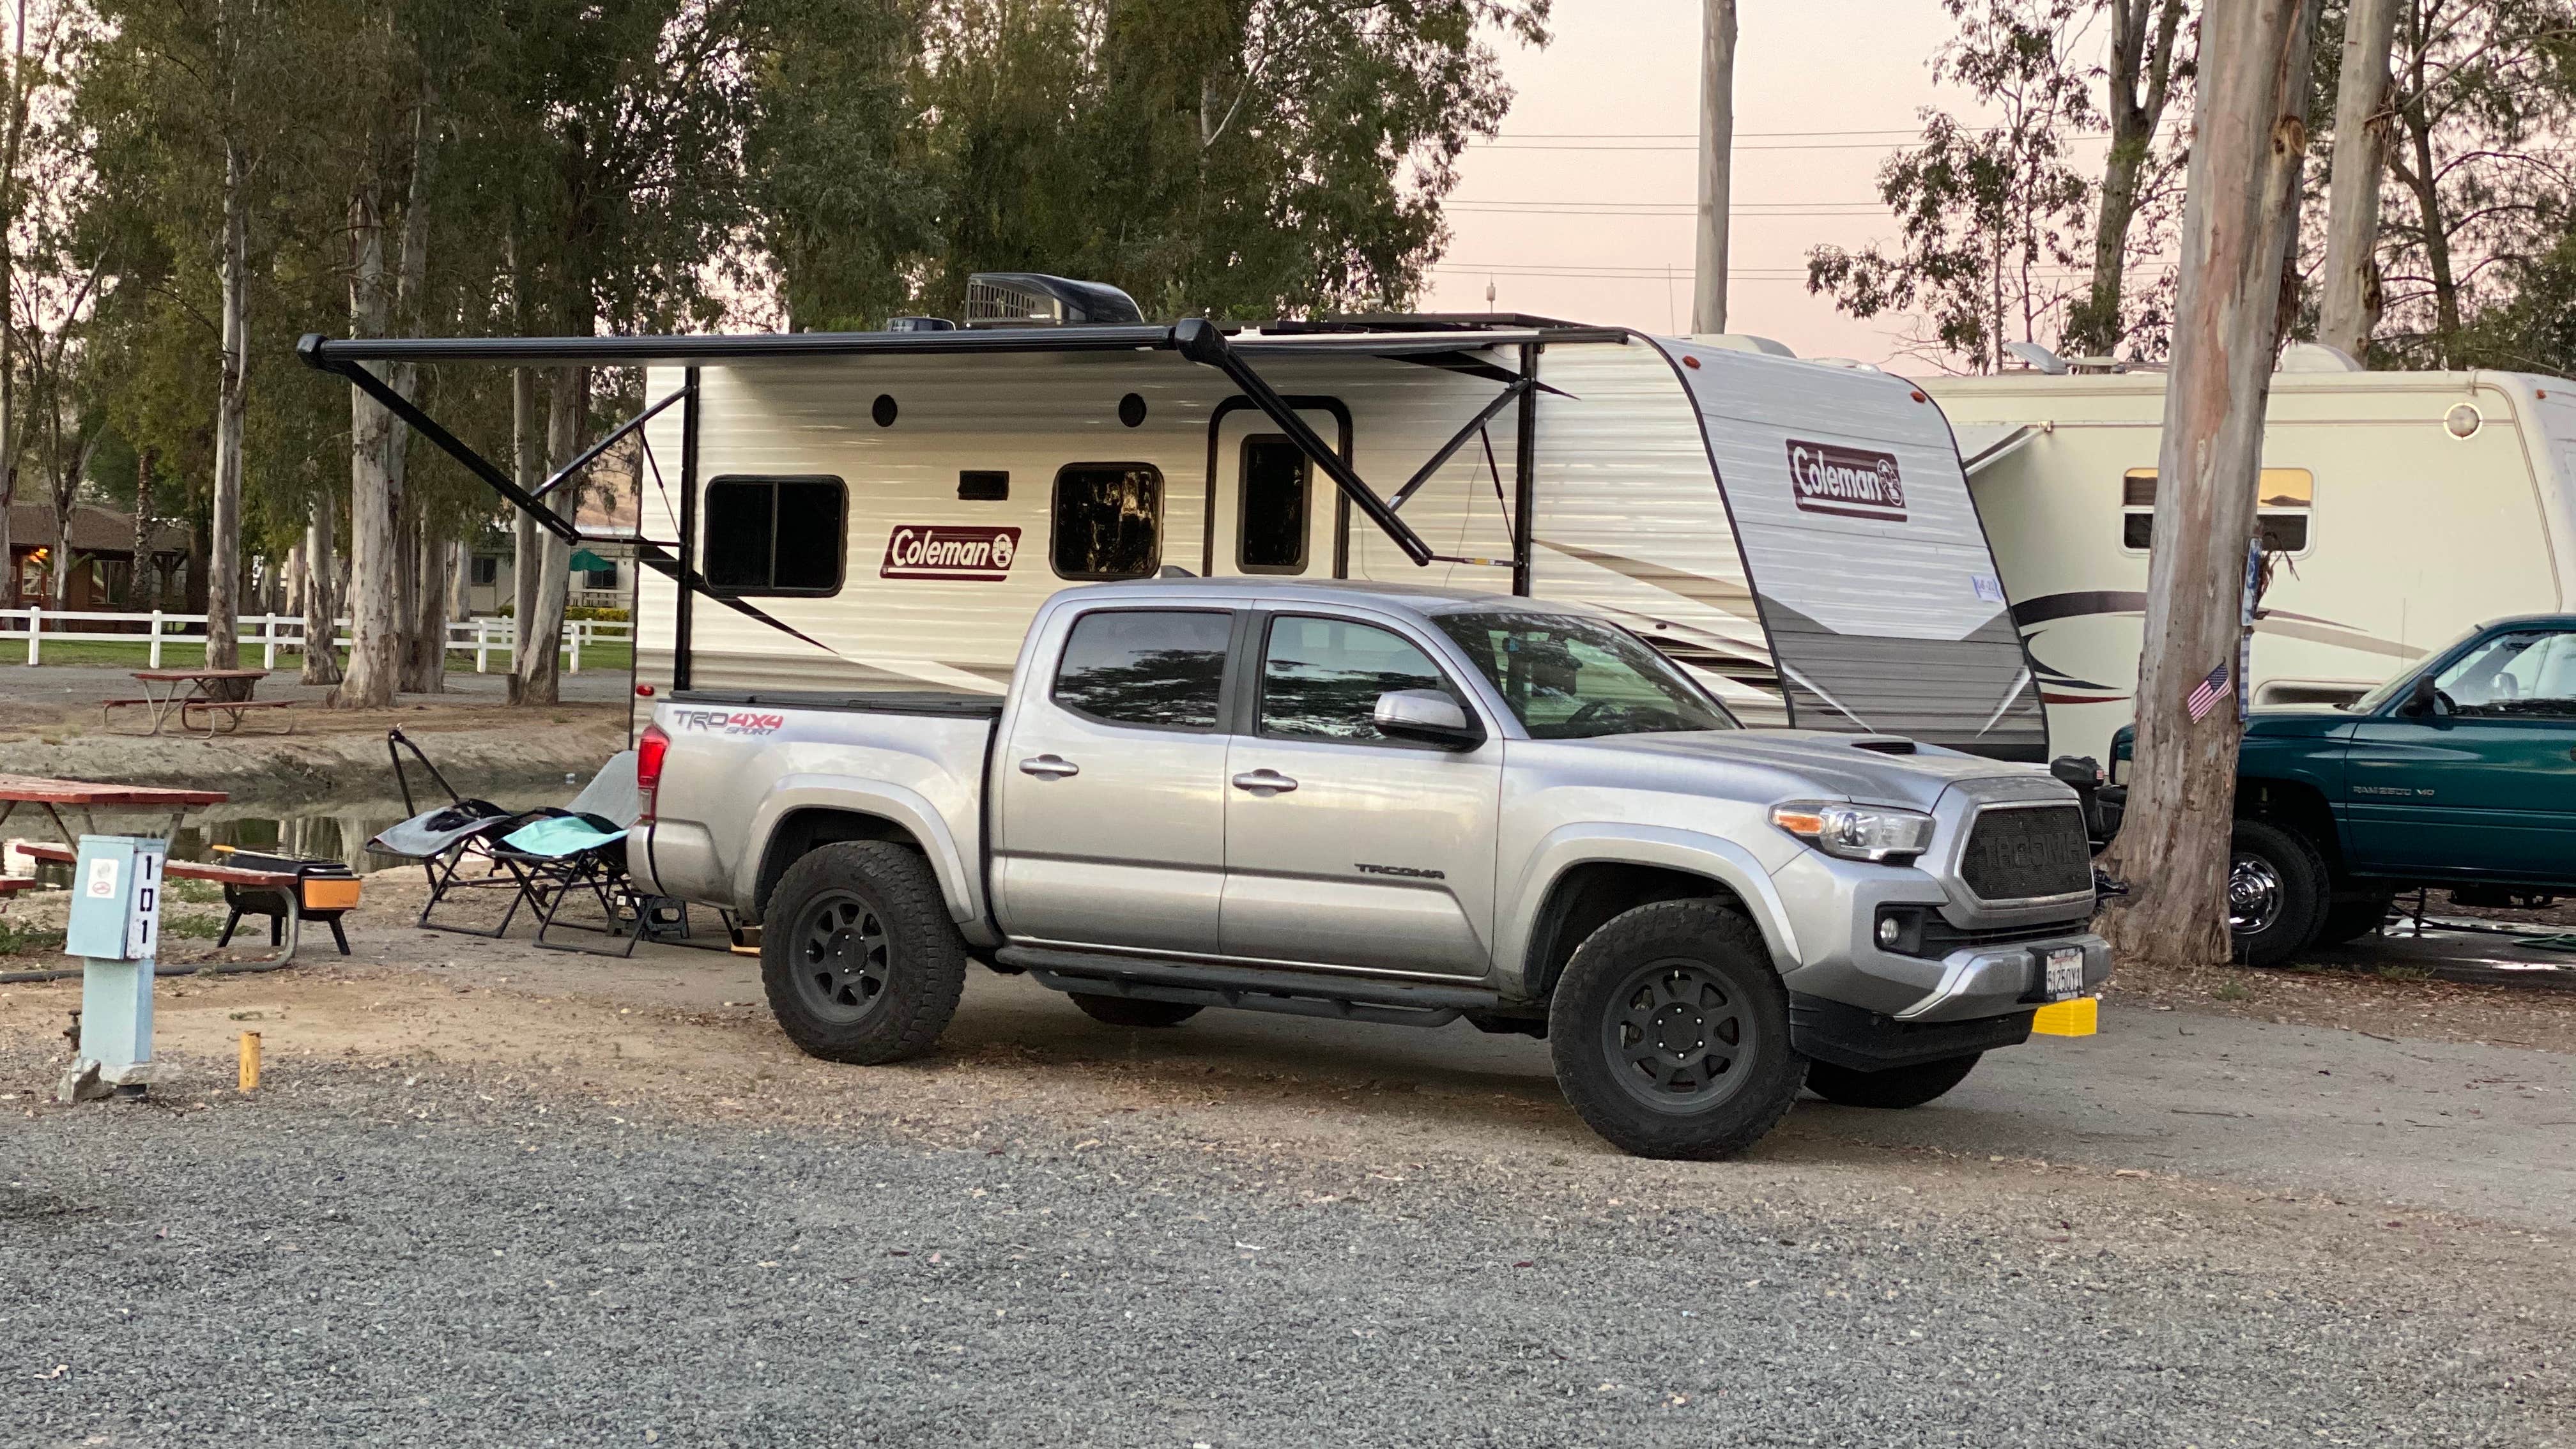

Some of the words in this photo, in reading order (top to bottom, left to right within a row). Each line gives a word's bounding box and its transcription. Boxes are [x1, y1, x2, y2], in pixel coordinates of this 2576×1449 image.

[1793, 446, 1883, 502] Coleman
[891, 528, 990, 567] Coleman
[673, 710, 729, 732] TRD
[724, 726, 777, 735] SPORT
[2352, 786, 2378, 794] RAM
[2379, 787, 2412, 795] 2500
[1978, 831, 2082, 868] TACOMA
[1354, 863, 1445, 880] TACOMA
[140, 855, 154, 944] 101
